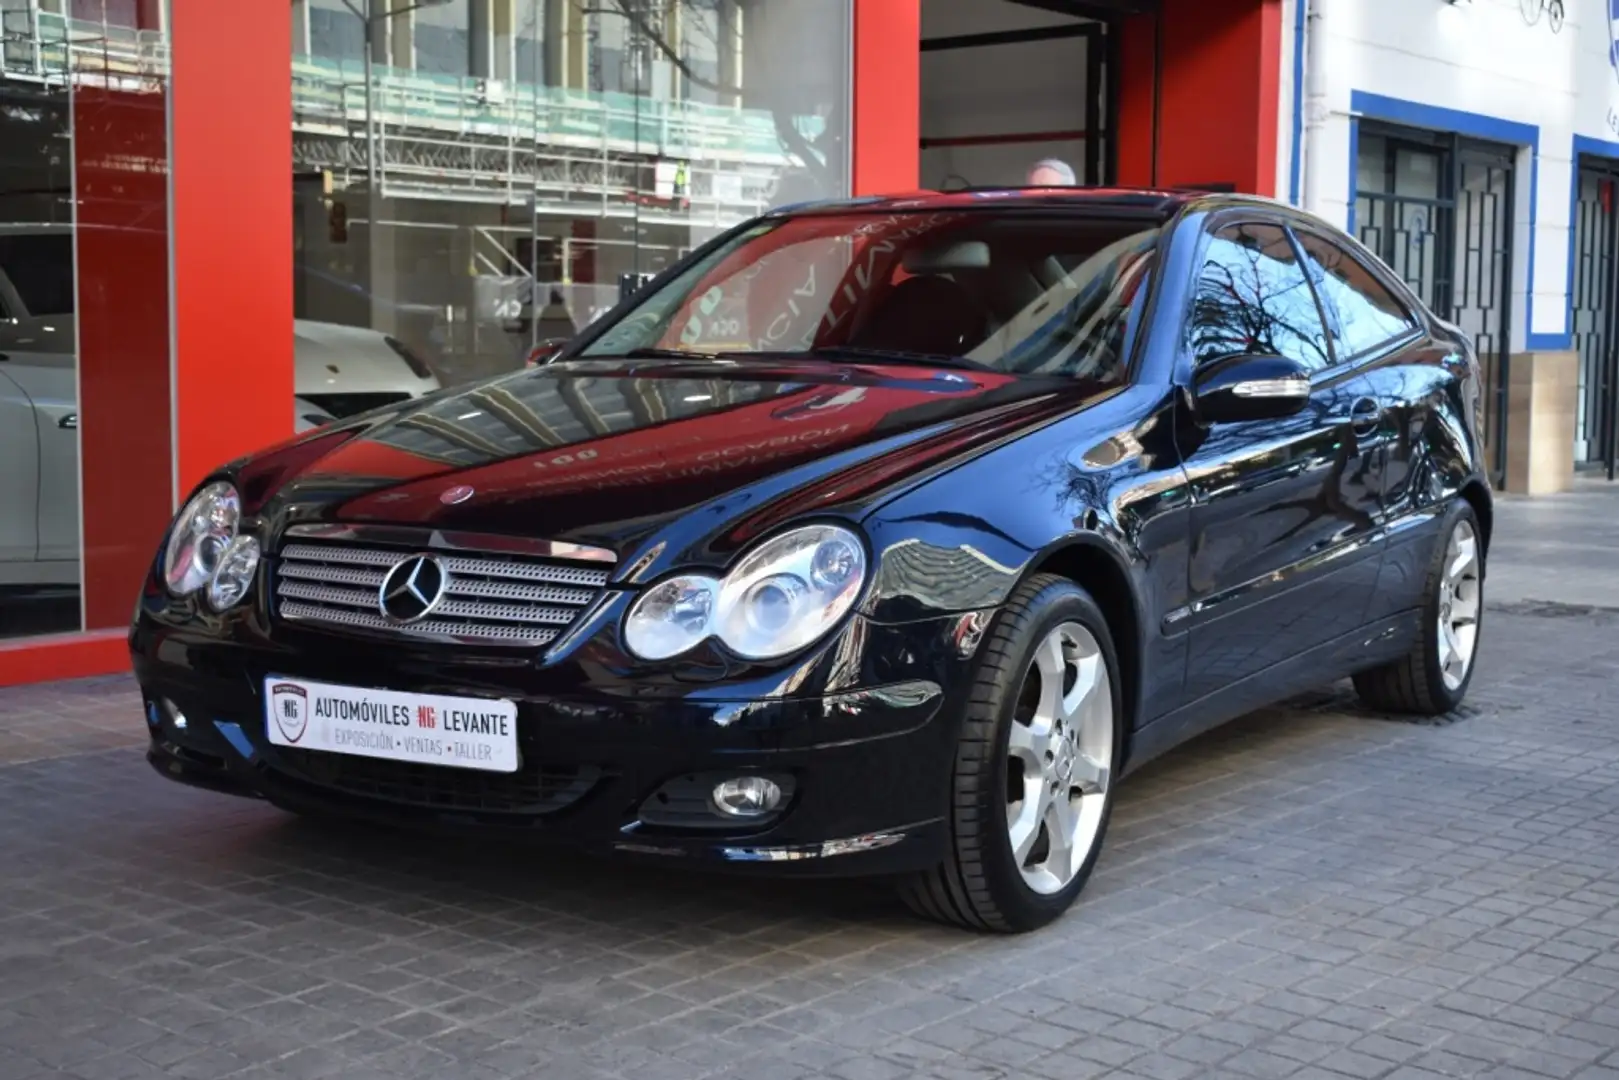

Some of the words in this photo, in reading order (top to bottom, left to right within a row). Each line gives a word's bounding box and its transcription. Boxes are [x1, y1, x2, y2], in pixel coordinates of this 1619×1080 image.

[315, 697, 410, 727] AUTOMÓVILES
[416, 701, 436, 728] NG
[443, 710, 508, 736] LEVANTE
[335, 727, 394, 751] EXPOSICIÓN
[404, 736, 443, 757] VENTAS
[454, 741, 492, 761] TALLER
